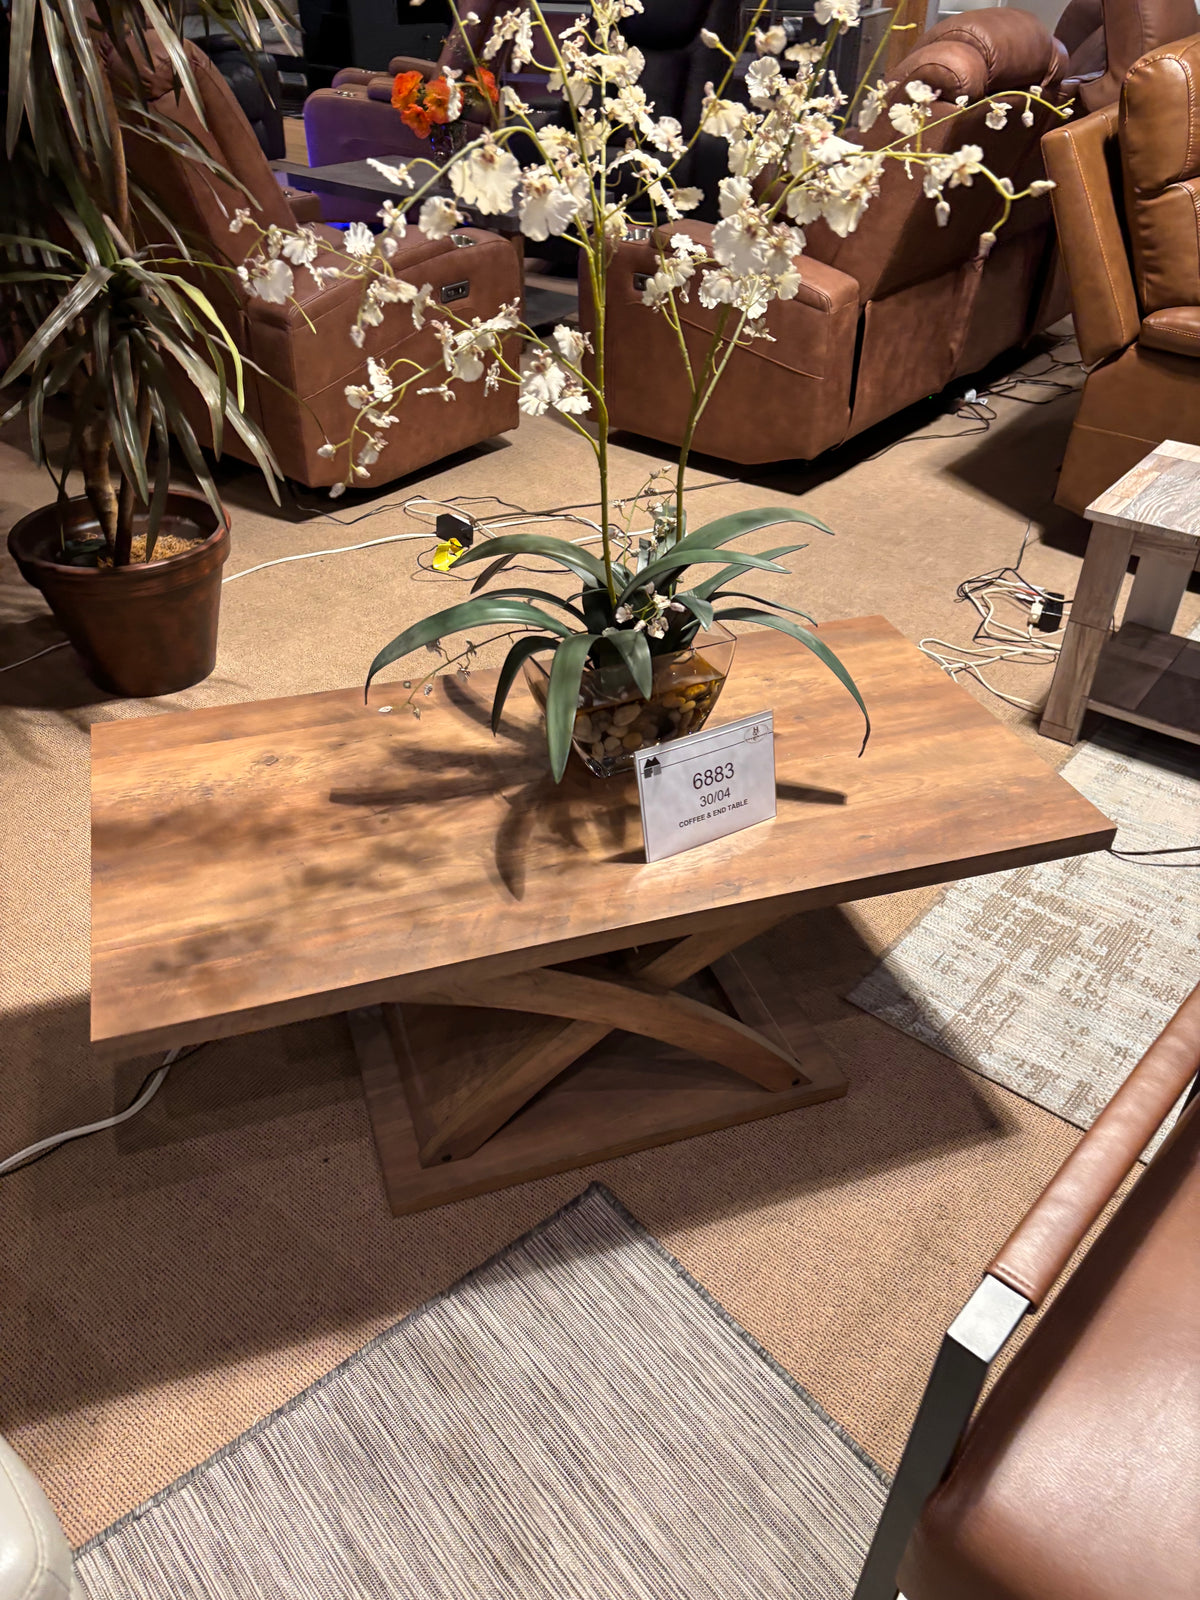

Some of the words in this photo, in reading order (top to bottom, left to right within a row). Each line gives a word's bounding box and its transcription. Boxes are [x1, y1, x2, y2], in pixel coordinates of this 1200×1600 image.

[693, 762, 734, 789] 6883
[700, 787, 731, 807] 30/04
[679, 814, 706, 828] COFFEE
[713, 807, 727, 817] END
[727, 799, 748, 811] TABLE
